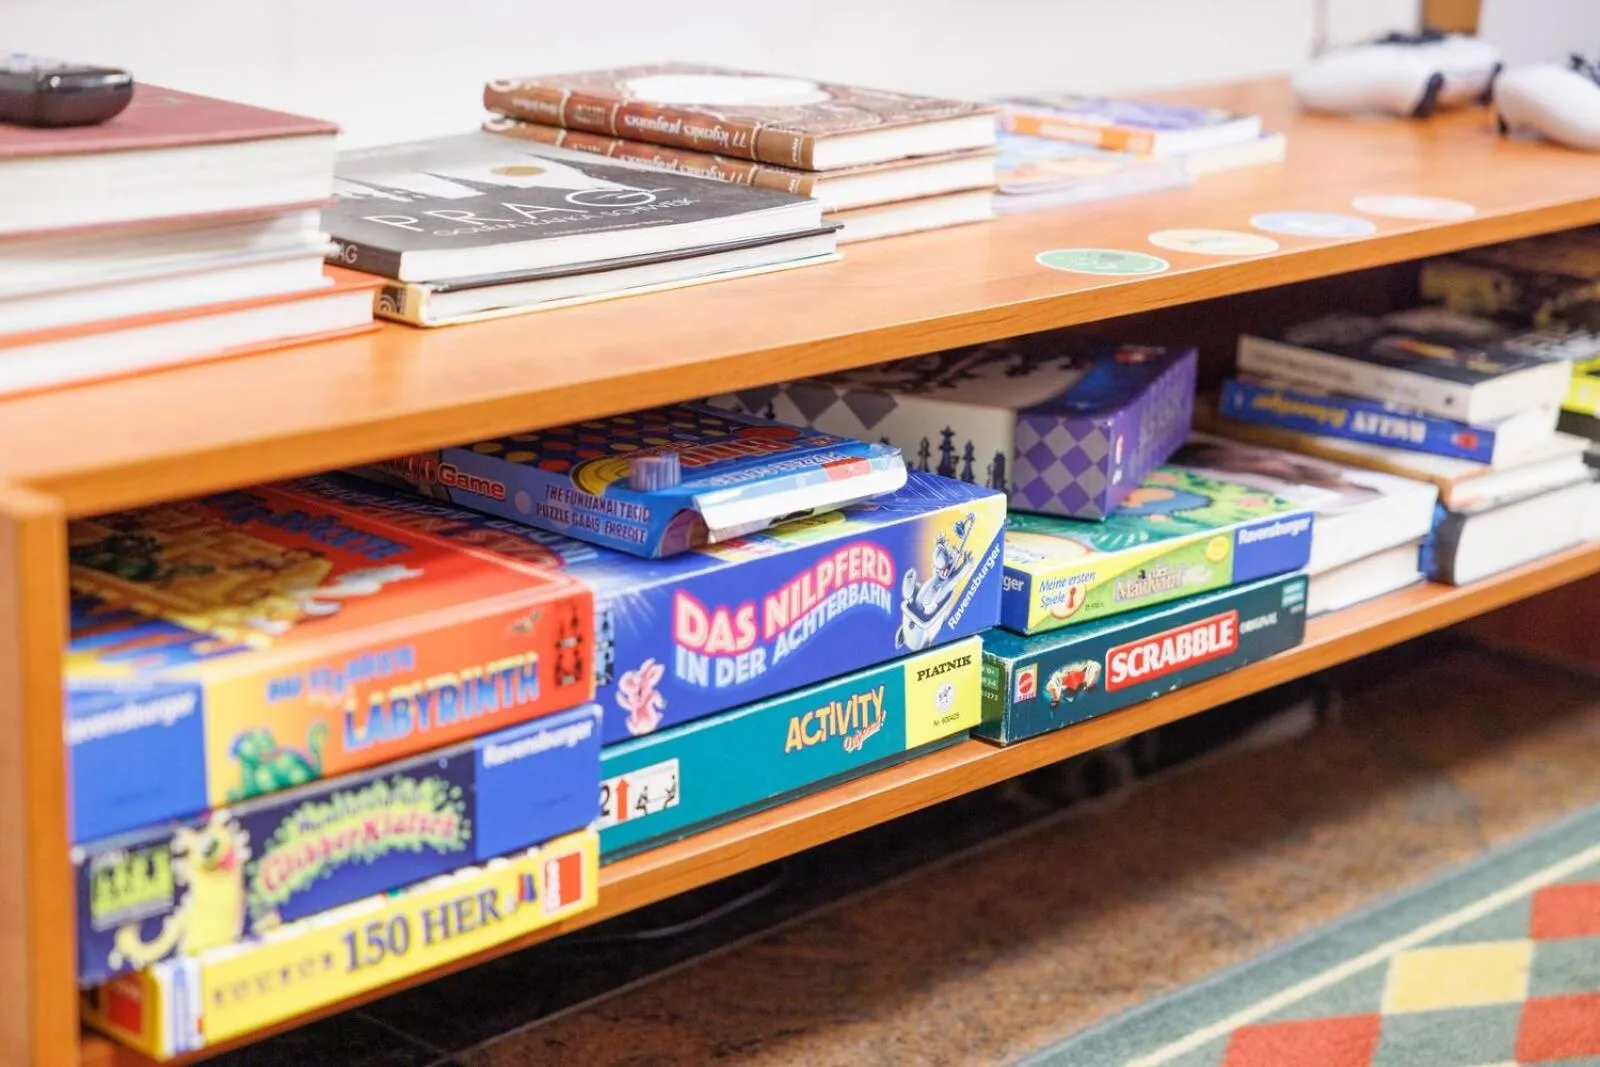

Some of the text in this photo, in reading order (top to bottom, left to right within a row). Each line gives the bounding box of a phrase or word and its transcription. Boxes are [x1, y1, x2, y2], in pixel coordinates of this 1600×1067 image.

[731, 132, 748, 149] 77
[361, 187, 674, 232] PRAG
[438, 463, 507, 501] Game
[676, 545, 895, 652] DAS NILPFERD
[948, 544, 1002, 630] Ravensburger
[1039, 576, 1067, 593] Meine
[1067, 571, 1096, 588] ersten
[1040, 593, 1067, 610] Spiele
[675, 581, 893, 688] IN DER ACHTERBAHN
[1110, 618, 1235, 684] SCRABBLE
[916, 654, 972, 682] PIATNIK
[342, 651, 541, 752] LABYRINTH
[785, 684, 885, 754] ACTIVITY
[342, 887, 504, 974] 150 HER
